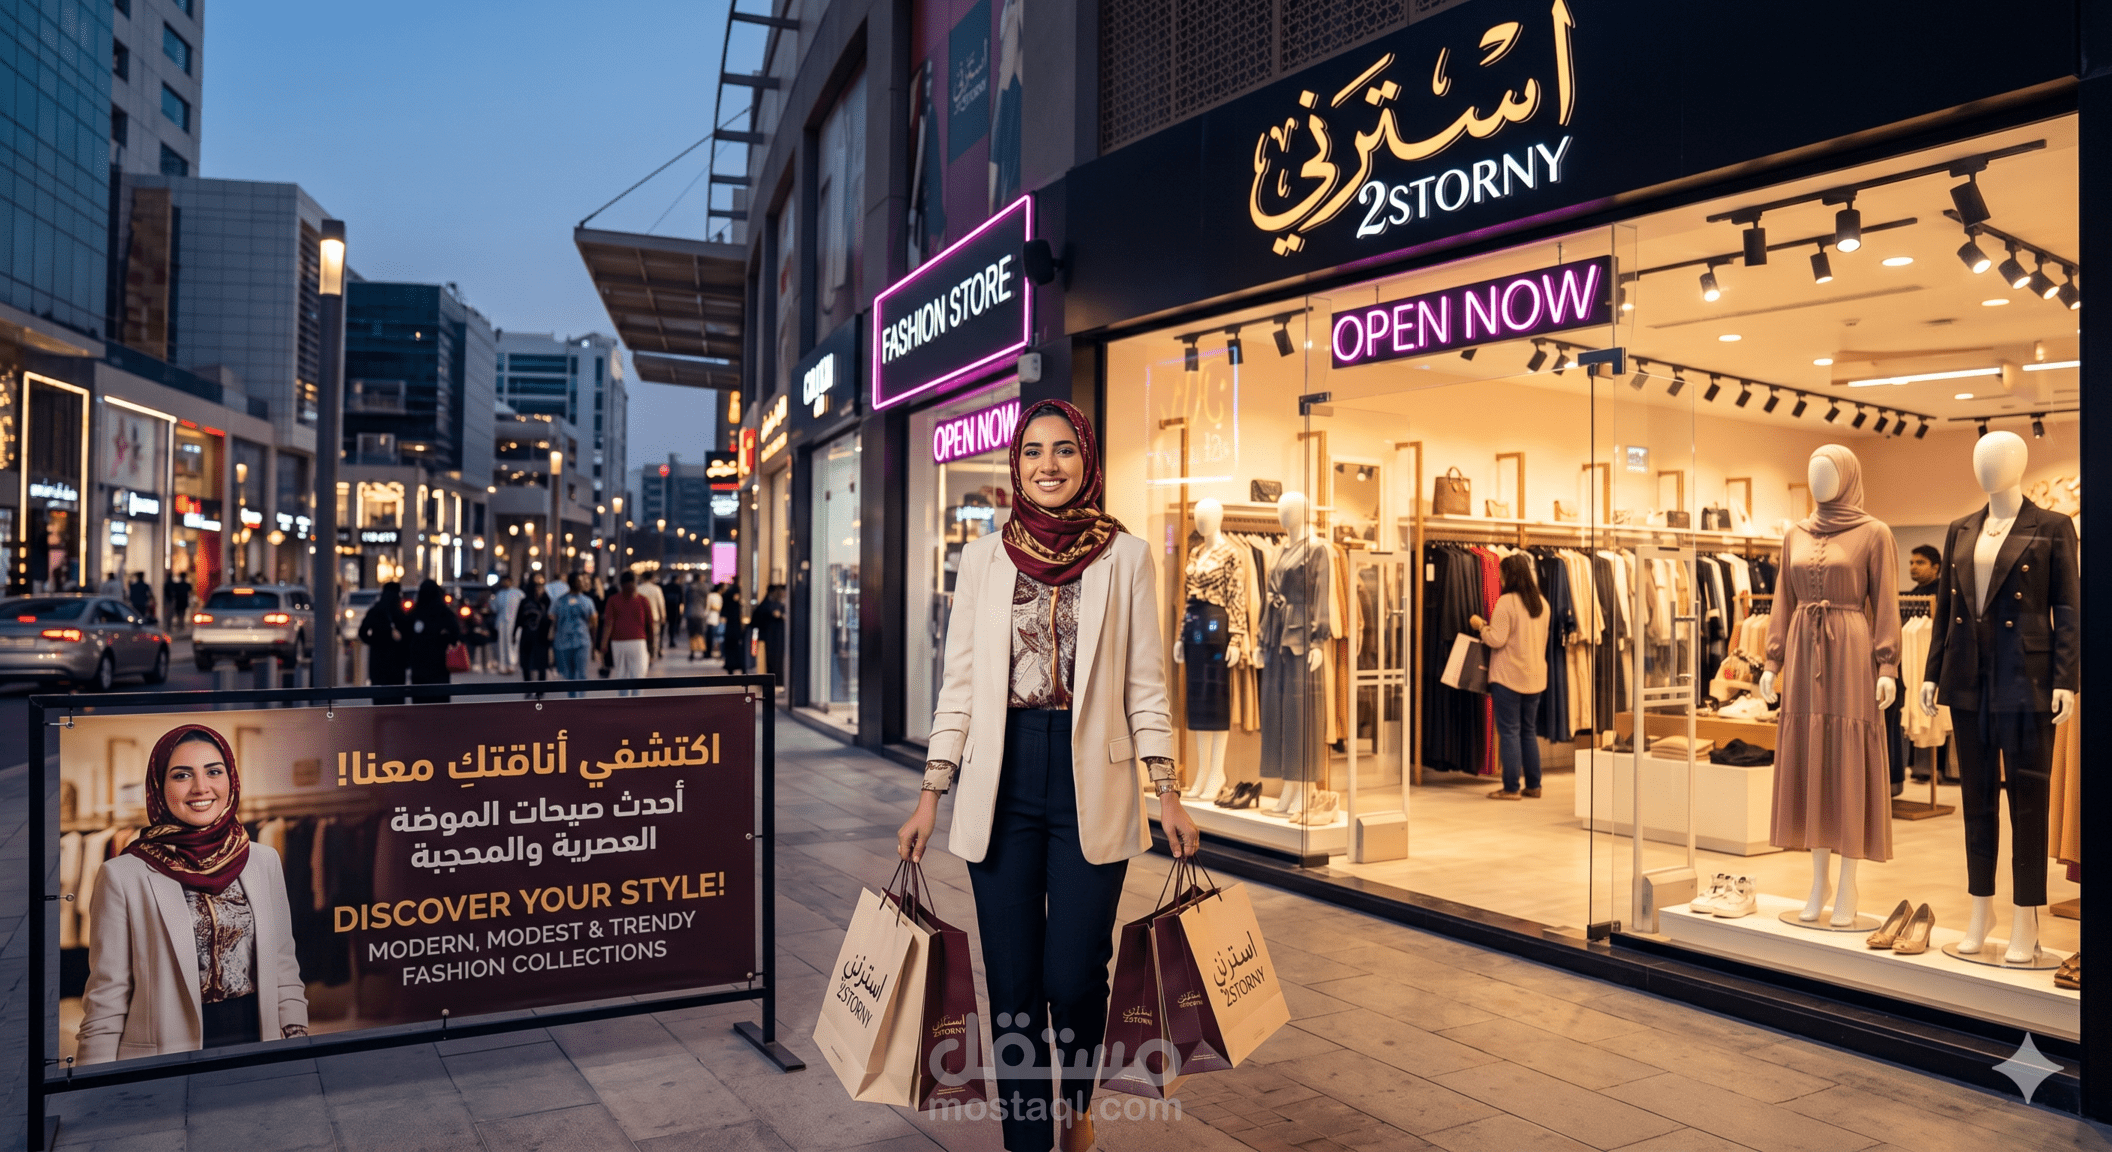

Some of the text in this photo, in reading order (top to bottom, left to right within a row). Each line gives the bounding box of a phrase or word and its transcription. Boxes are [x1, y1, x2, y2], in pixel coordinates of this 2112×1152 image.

[1356, 135, 1571, 240] 2STORNY
[881, 253, 1012, 365] FASHION STORE
[1331, 263, 1599, 362] OPEN NOW
[933, 401, 1021, 462] OPEN NOW
[337, 750, 434, 787] معنا!
[579, 731, 721, 788] اكتشفي
[390, 779, 685, 837] أحدث صيحات الموضة
[410, 825, 657, 875] العصرية والمحجبة
[333, 871, 726, 934] DISCOVER YOUR STYLE!
[368, 910, 697, 962] MODERN, MODEST & TRENDY
[402, 940, 668, 987] FASHION COLLECTIONS
[836, 984, 873, 1029] 2STORNY
[1222, 965, 1265, 1008] 2STORNY
